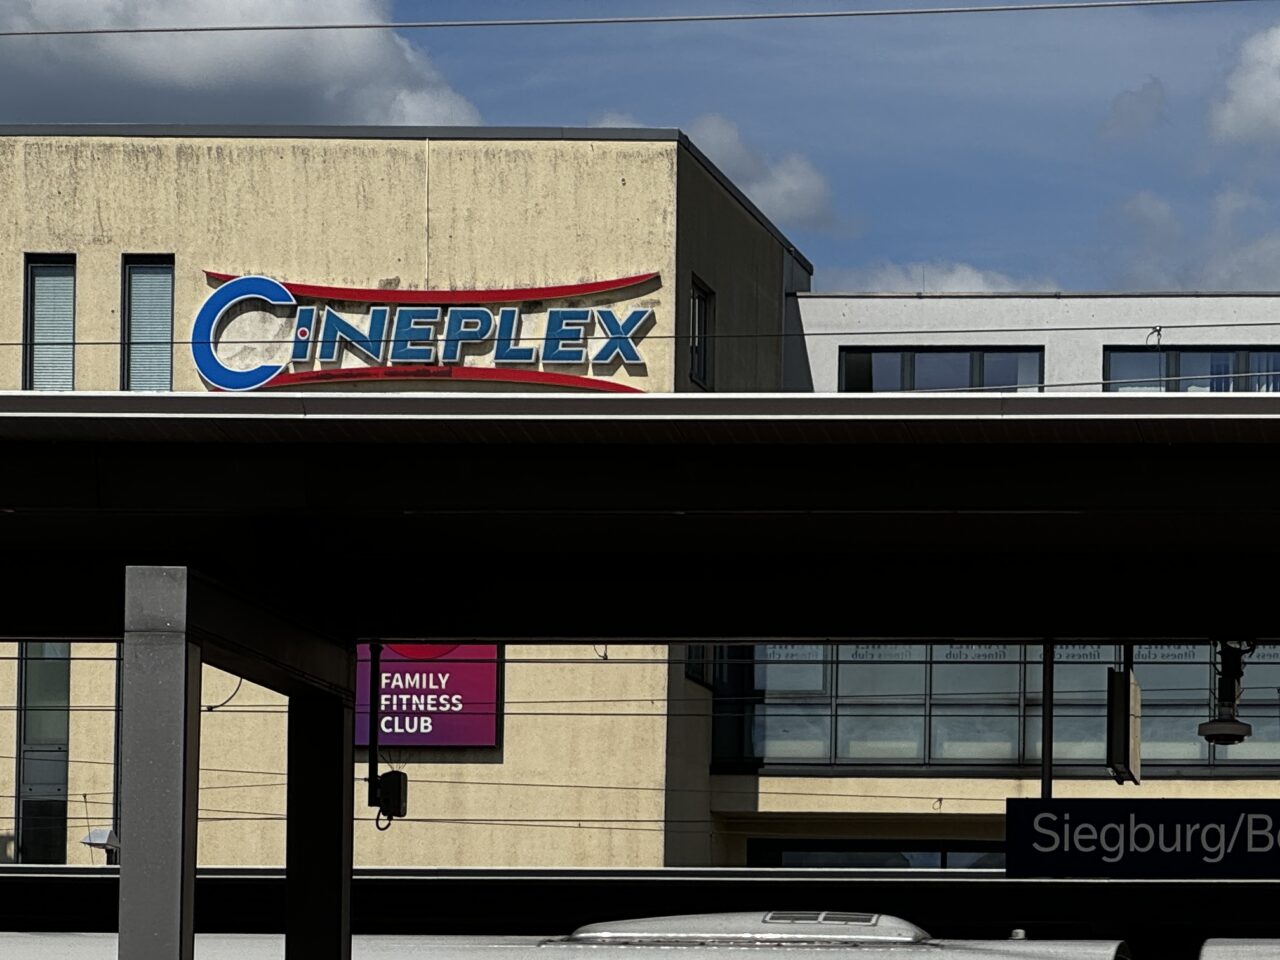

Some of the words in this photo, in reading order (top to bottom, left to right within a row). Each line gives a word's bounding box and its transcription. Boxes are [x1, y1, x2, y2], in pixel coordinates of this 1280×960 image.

[380, 672, 450, 690] FAMILY
[380, 695, 463, 712] FITNESS
[380, 717, 433, 734] CLUB
